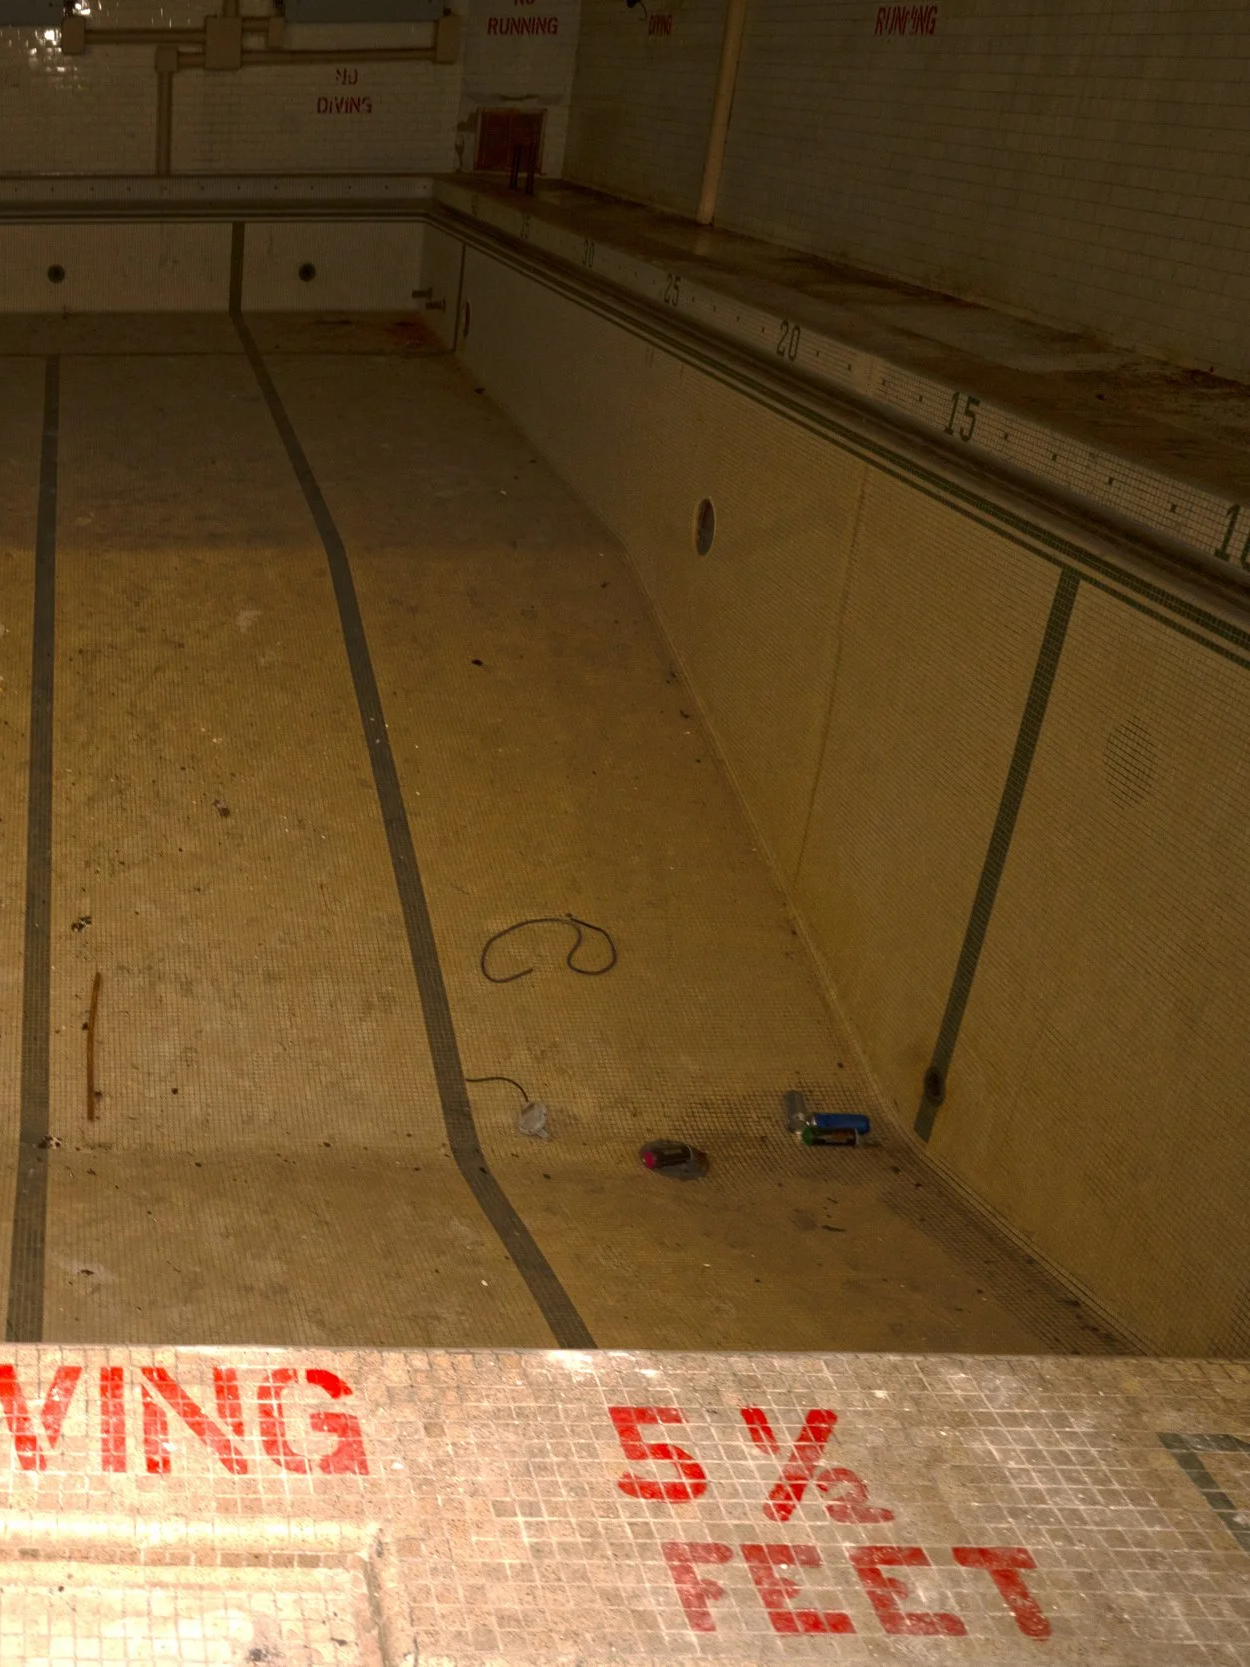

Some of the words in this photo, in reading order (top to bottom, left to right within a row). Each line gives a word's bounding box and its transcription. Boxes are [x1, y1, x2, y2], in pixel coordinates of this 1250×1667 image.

[487, 16, 558, 35] RUNNING
[317, 96, 372, 114] DIVING
[664, 273, 681, 307] 25
[776, 319, 801, 361] 20
[944, 391, 981, 442] 15
[661, 1541, 1049, 1641] FEET
